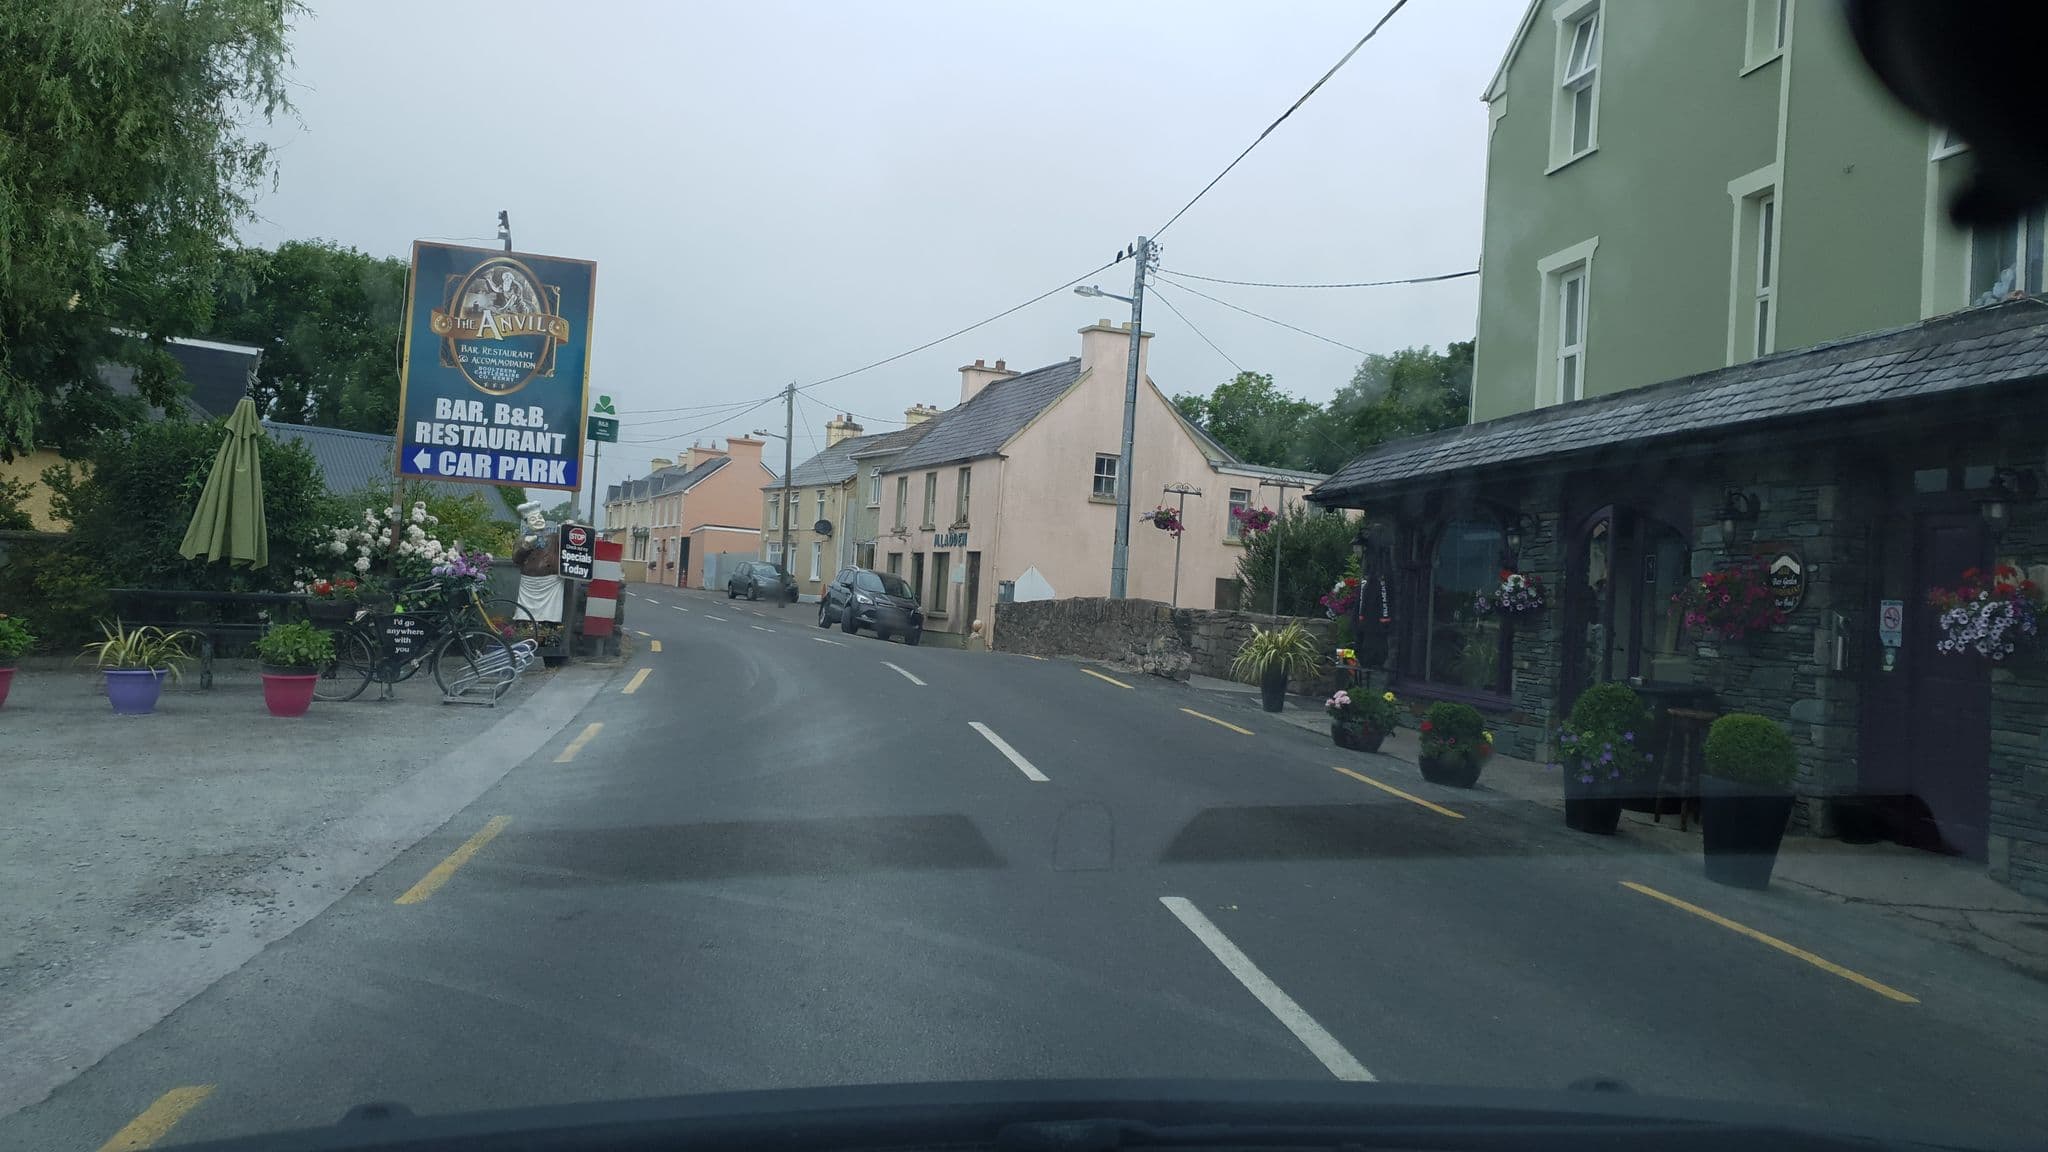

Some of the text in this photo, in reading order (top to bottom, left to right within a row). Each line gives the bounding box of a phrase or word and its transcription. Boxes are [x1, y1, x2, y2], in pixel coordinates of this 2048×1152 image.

[454, 310, 546, 340] THE ANVIL
[482, 347, 534, 360] RESTAURANT
[471, 356, 536, 370] ACCOMMODATION
[435, 397, 549, 431] BAR, B&B,
[415, 421, 566, 455] RESTAURANT
[438, 451, 567, 484] CAR PARK
[570, 532, 586, 541] STOP
[561, 549, 592, 563] Specials
[563, 563, 589, 578] Today
[393, 618, 403, 626] I'd
[386, 628, 425, 637] anywhere
[394, 636, 411, 644] with
[394, 646, 410, 654] you
